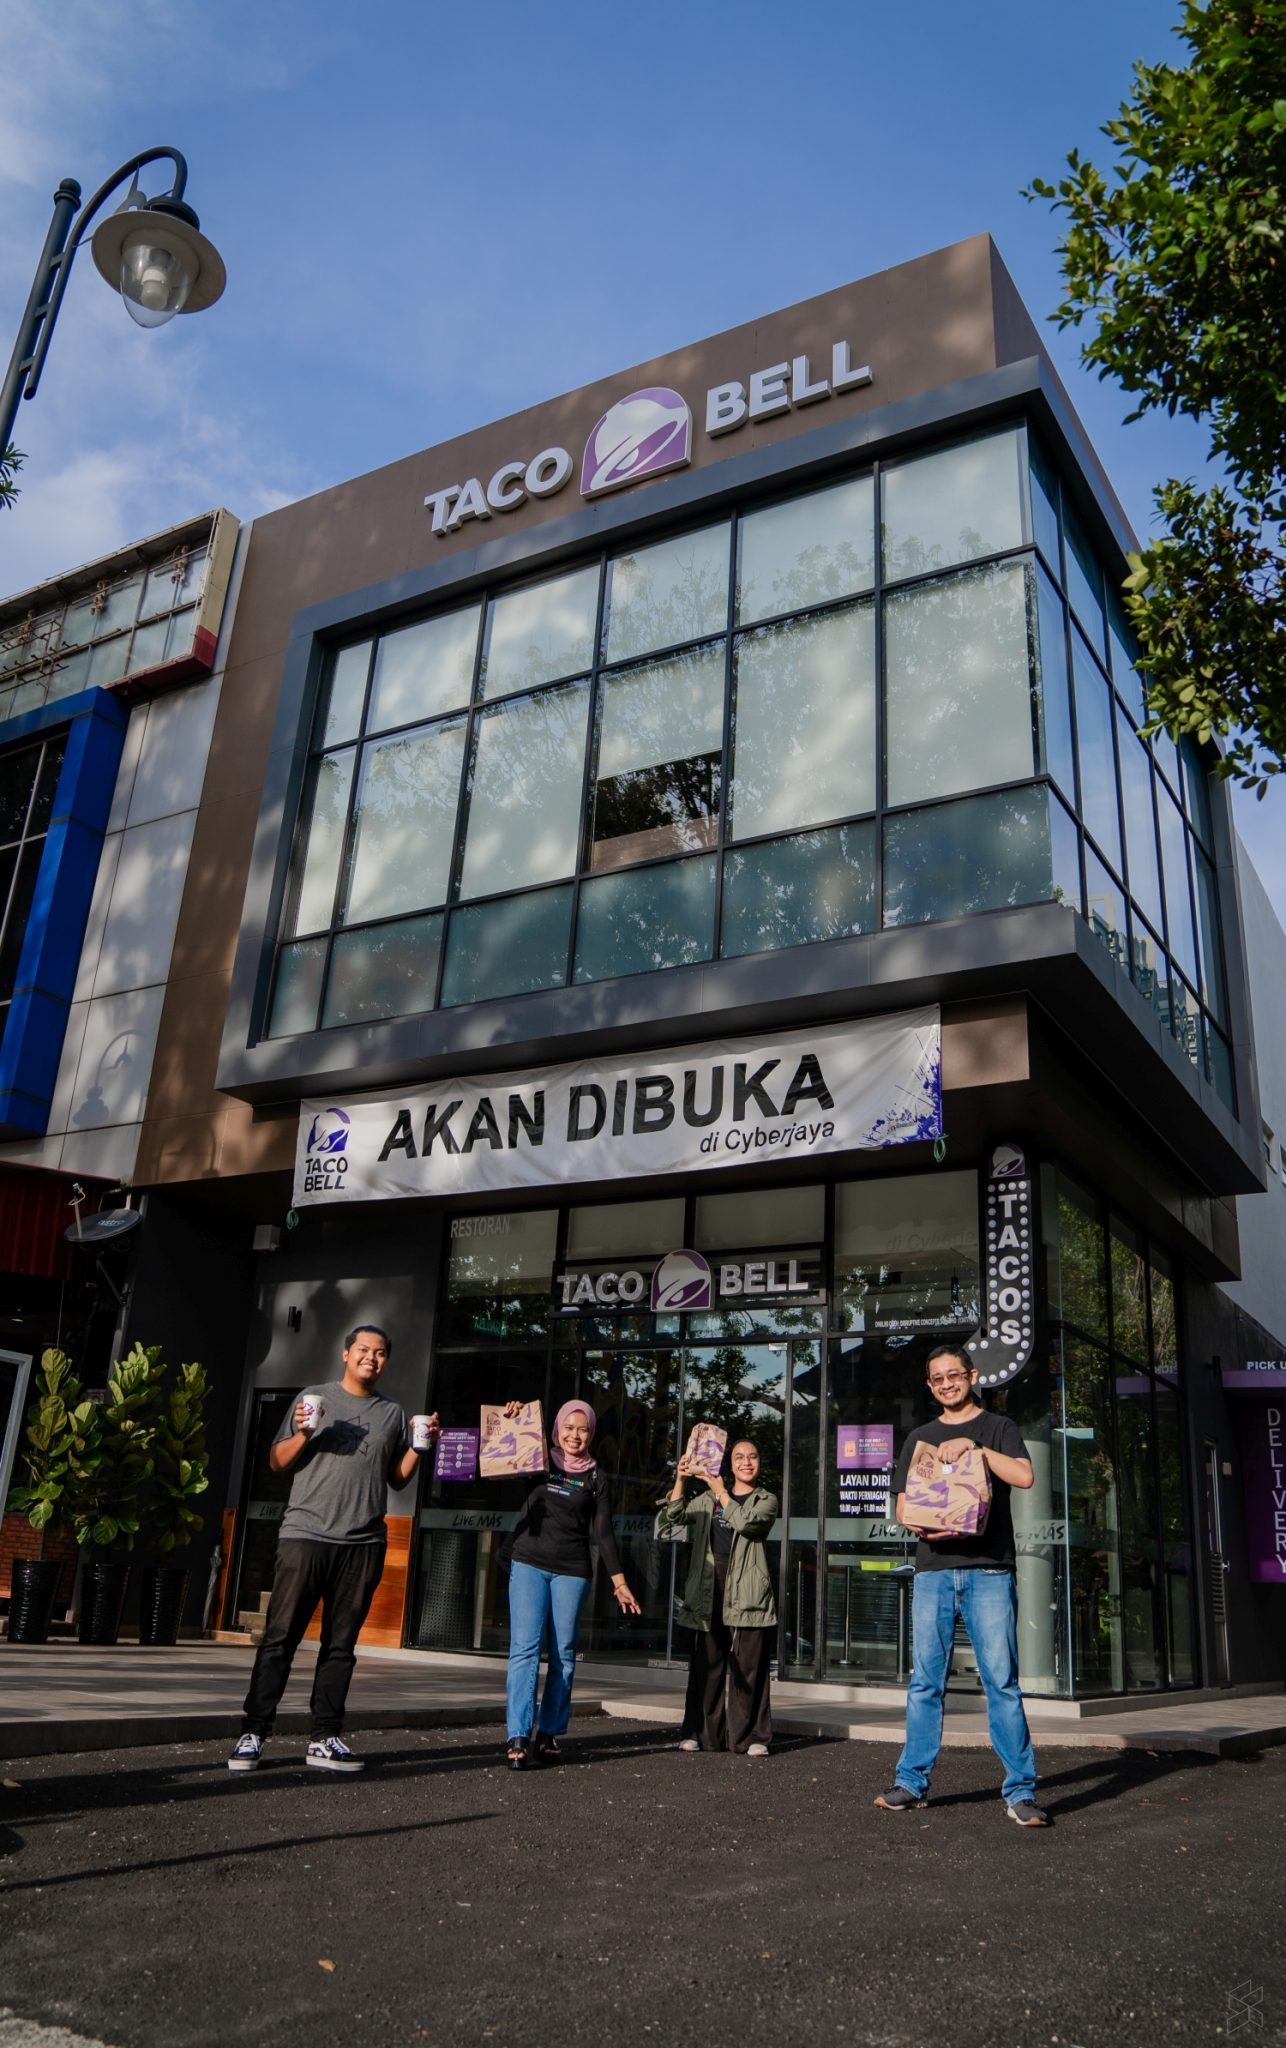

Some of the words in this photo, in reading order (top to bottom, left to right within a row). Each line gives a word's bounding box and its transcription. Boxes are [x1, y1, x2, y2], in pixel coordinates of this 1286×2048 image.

[423, 446, 574, 536] TACO
[705, 340, 872, 439] BELL
[377, 1090, 545, 1162] AKAN
[567, 1053, 835, 1142] DIBUKA
[700, 1132, 720, 1153] di
[725, 1121, 835, 1154] Cyberjaya
[305, 1157, 348, 1175] TACO
[304, 1174, 346, 1193] BELL
[450, 1216, 511, 1239] RESTORAN
[557, 1270, 646, 1304] TACO
[720, 1259, 809, 1296] BELL
[997, 1194, 1022, 1345] TACOS
[1246, 1361, 1276, 1370] PICK
[840, 1474, 869, 1486] LAYAN
[871, 1474, 890, 1486] DIRI
[1267, 1408, 1286, 1574] DELIVERY
[840, 1490, 857, 1500] WAKTU
